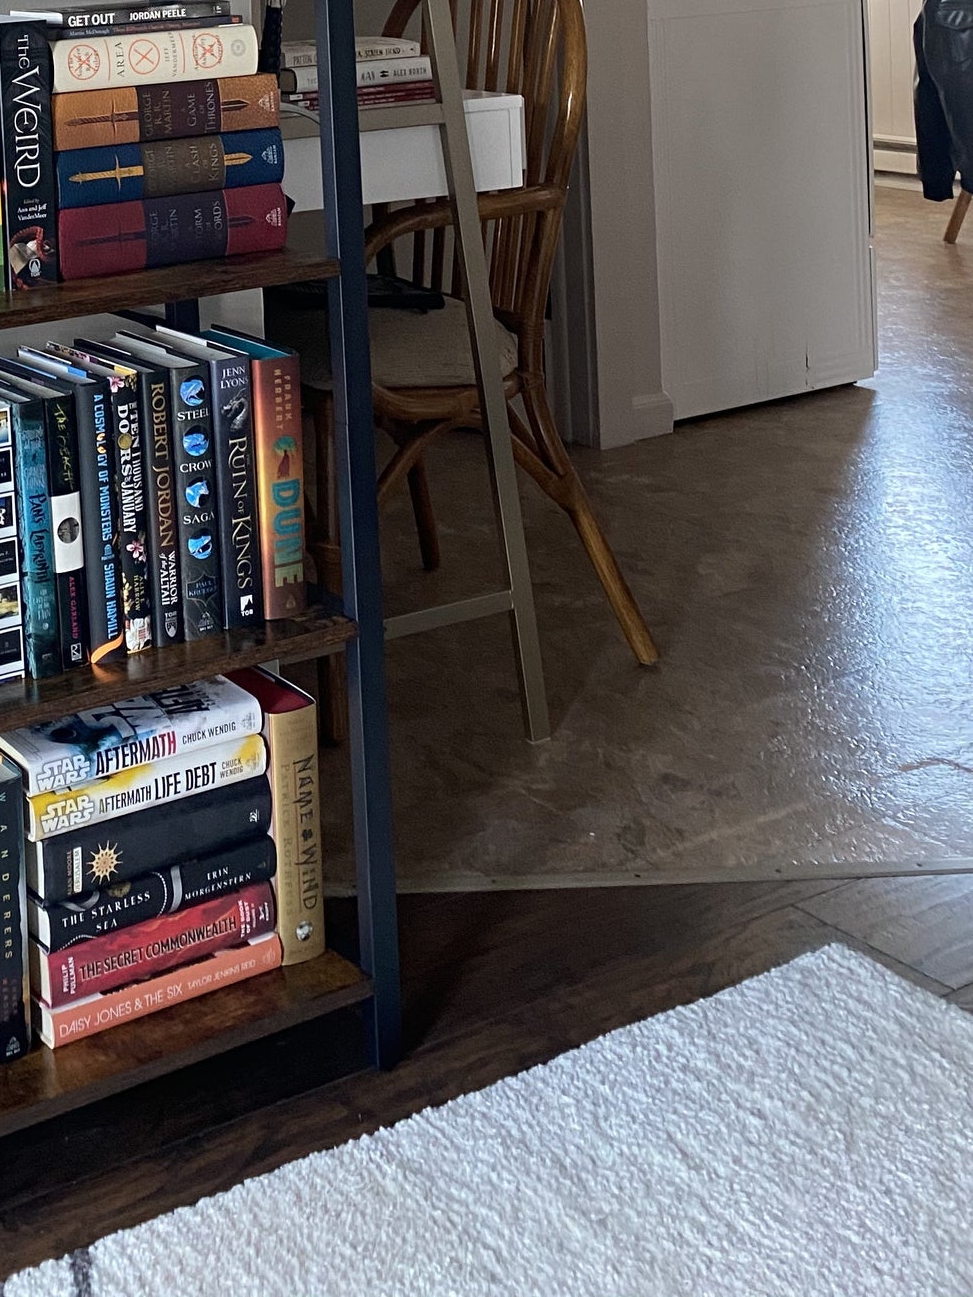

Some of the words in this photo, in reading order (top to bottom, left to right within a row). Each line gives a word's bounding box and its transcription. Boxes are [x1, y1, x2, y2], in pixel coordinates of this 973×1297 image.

[68, 14, 91, 27] GET
[92, 13, 115, 25] OUT
[129, 10, 160, 20] JORDAN
[162, 8, 186, 18] PEELE
[393, 69, 407, 77] ALEX
[205, 82, 216, 133] THRONES
[209, 143, 219, 182] KINGS
[150, 383, 169, 460] ROBERT
[228, 436, 249, 498] RUIN
[153, 465, 173, 547] JORDAN
[237, 500, 244, 514] OF
[232, 515, 252, 590] KINGS
[271, 479, 304, 588] DUNE
[95, 731, 176, 776] AFTERMATH
[183, 730, 205, 745] CHUCK
[207, 722, 236, 739] WENDIG
[99, 785, 152, 814] AFTERMATH
[154, 777, 182, 800] LIFE
[185, 771, 217, 796] DEBT
[293, 754, 315, 827] NAME
[80, 958, 103, 982] THE
[103, 949, 144, 973] SECRET
[145, 917, 236, 958] COMMONWEALTH
[60, 1015, 93, 1038] DAISY
[93, 1000, 132, 1024] JONES
[134, 996, 143, 1010] &
[144, 989, 164, 1007] THE
[167, 984, 183, 1003] SIX
